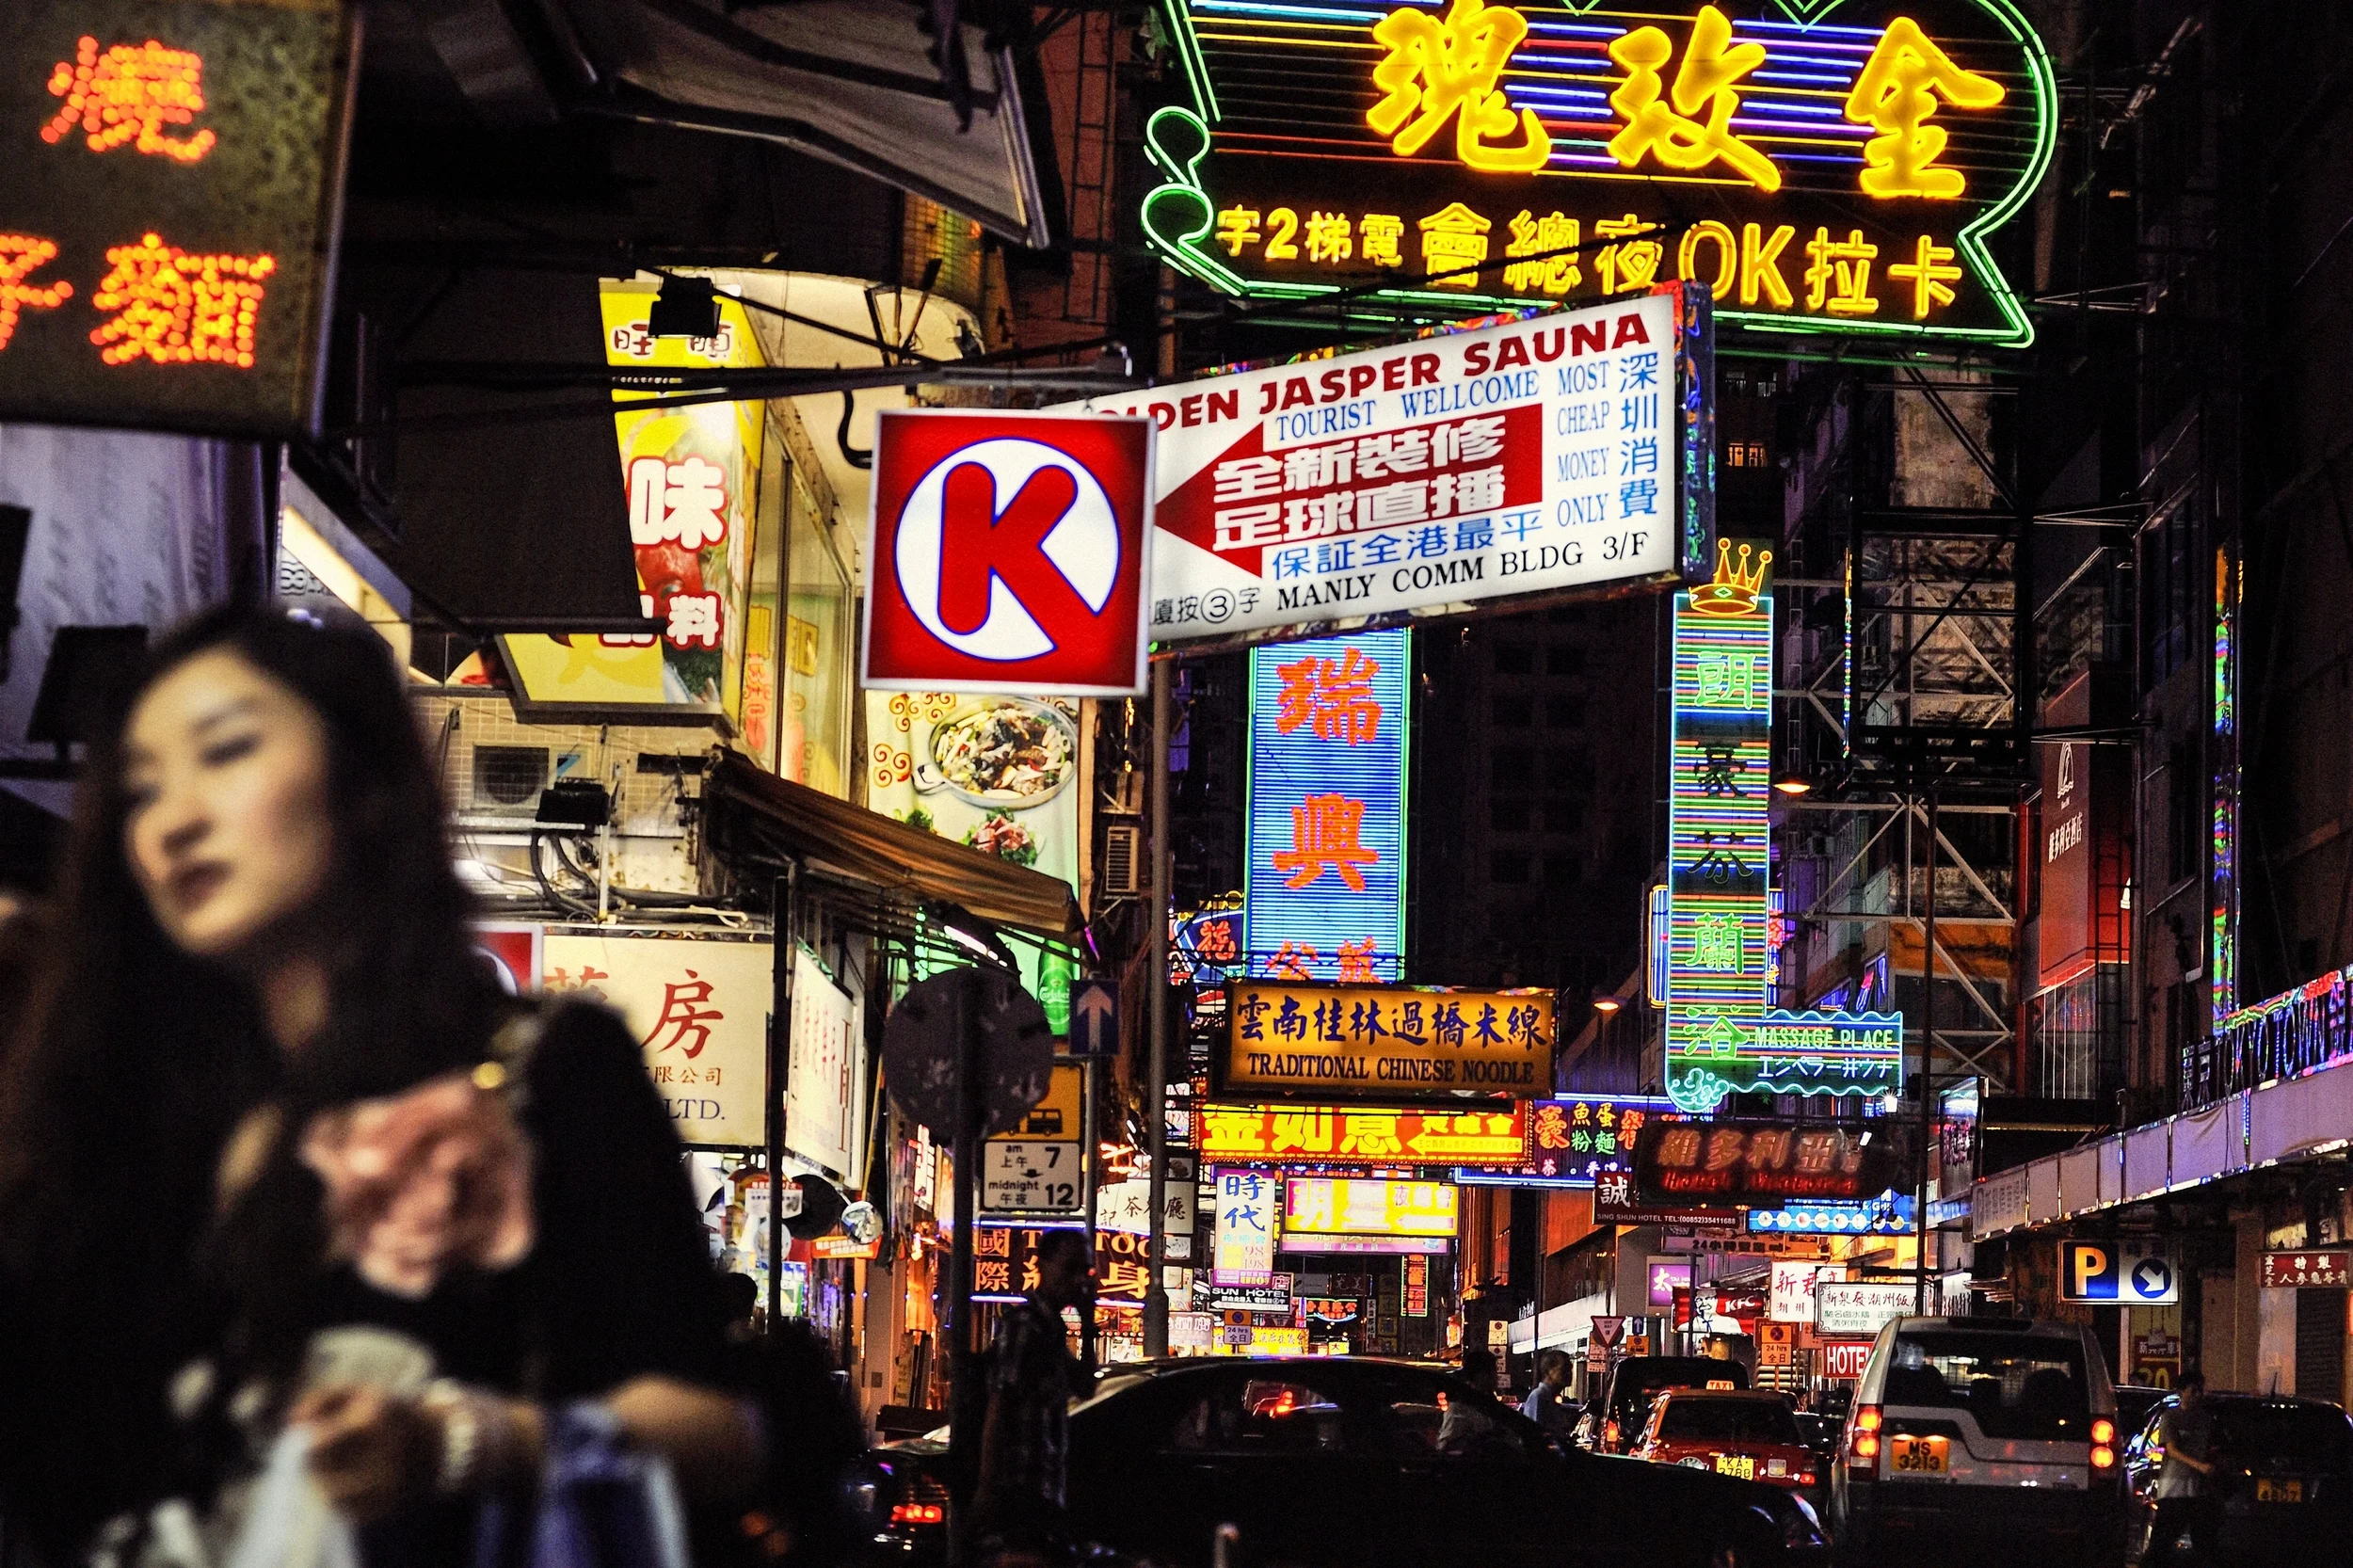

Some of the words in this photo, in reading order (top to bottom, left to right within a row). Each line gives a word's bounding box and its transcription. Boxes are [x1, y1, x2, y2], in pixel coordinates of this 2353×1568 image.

[1259, 353, 1441, 416] JASPER
[1463, 313, 1650, 376] SAUNA
[1558, 361, 1610, 396] MOST
[1276, 400, 1377, 440] TOURIST
[1401, 371, 1541, 418] WELLCOME
[1558, 401, 1610, 436] CHEAP
[1618, 352, 1658, 519] 深圳消費
[1213, 415, 1506, 503] 全新裝修
[1558, 447, 1610, 483] MONEY
[631, 457, 724, 549] 味
[1212, 465, 1506, 552] 足球直播
[1558, 493, 1609, 528] ONLY
[937, 461, 1099, 648] K
[1273, 509, 1544, 580] 保証全港最平
[1277, 574, 1375, 611] MANLY
[1393, 556, 1484, 593] COMM
[1500, 541, 1583, 577] BLDG
[1603, 531, 1649, 562] 3/F
[1236, 993, 1548, 1051] 雲南桂林過橋米線
[1754, 1026, 1833, 1048] MASSAGE
[1840, 1029, 1894, 1049] PLACE
[645, 1066, 722, 1086] 限公司
[1247, 1053, 1370, 1080] TRADITIONAL
[1377, 1057, 1455, 1082] CHINESE
[1462, 1061, 1535, 1085] NOODLE
[663, 1098, 725, 1120] LTD.
[1573, 1102, 1616, 1127] 魚蛋
[1202, 1104, 1402, 1154] 金如意
[1571, 1130, 1615, 1155] 粉麵
[1000, 1156, 1028, 1169] 上午
[1006, 1144, 1022, 1153] am
[1046, 1147, 1061, 1168] 7
[989, 1179, 1038, 1192] midnight
[1046, 1184, 1074, 1206] 12
[1000, 1192, 1028, 1206] 午夜
[1224, 1174, 1266, 1232] 時代
[1598, 1176, 1640, 1208] 誠
[1617, 1213, 1636, 1222] SHUN
[1639, 1214, 1662, 1223] HOTEL
[972, 1227, 1011, 1291] 國際
[2075, 1247, 2107, 1296] P
[1211, 1287, 1240, 1297] SUN
[1245, 1288, 1289, 1299] HOTEL
[1725, 1295, 1756, 1314] KFC
[1229, 1335, 1247, 1343] 全日
[1769, 1353, 1787, 1364] 全日
[1709, 1382, 1733, 1391] TAXI
[1726, 1458, 1743, 1468] KA
[1910, 1442, 1931, 1455] MS
